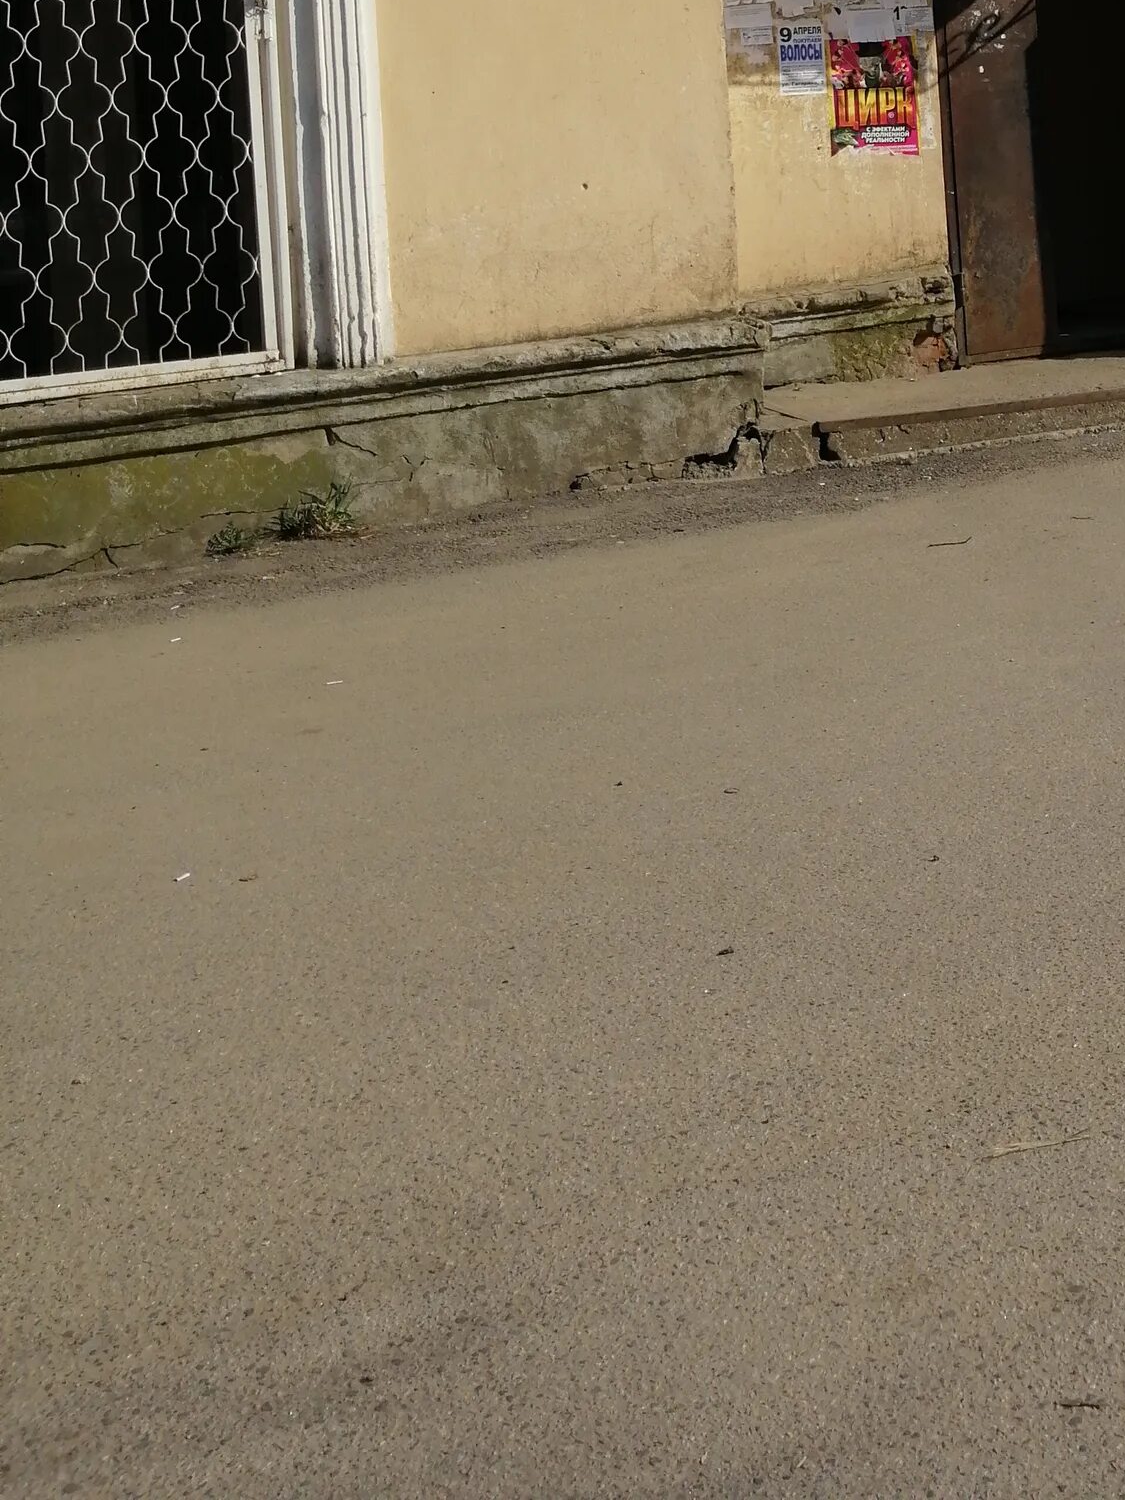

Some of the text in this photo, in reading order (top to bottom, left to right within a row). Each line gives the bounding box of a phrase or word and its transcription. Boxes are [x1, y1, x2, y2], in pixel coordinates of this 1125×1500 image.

[779, 27, 792, 42] 9
[793, 26, 822, 35] АПРЕЛЯ
[780, 43, 823, 62] ВОЛОСЫ
[837, 87, 916, 130] ЦИРК
[861, 130, 910, 138] ДОПОЛНЕННОЙ
